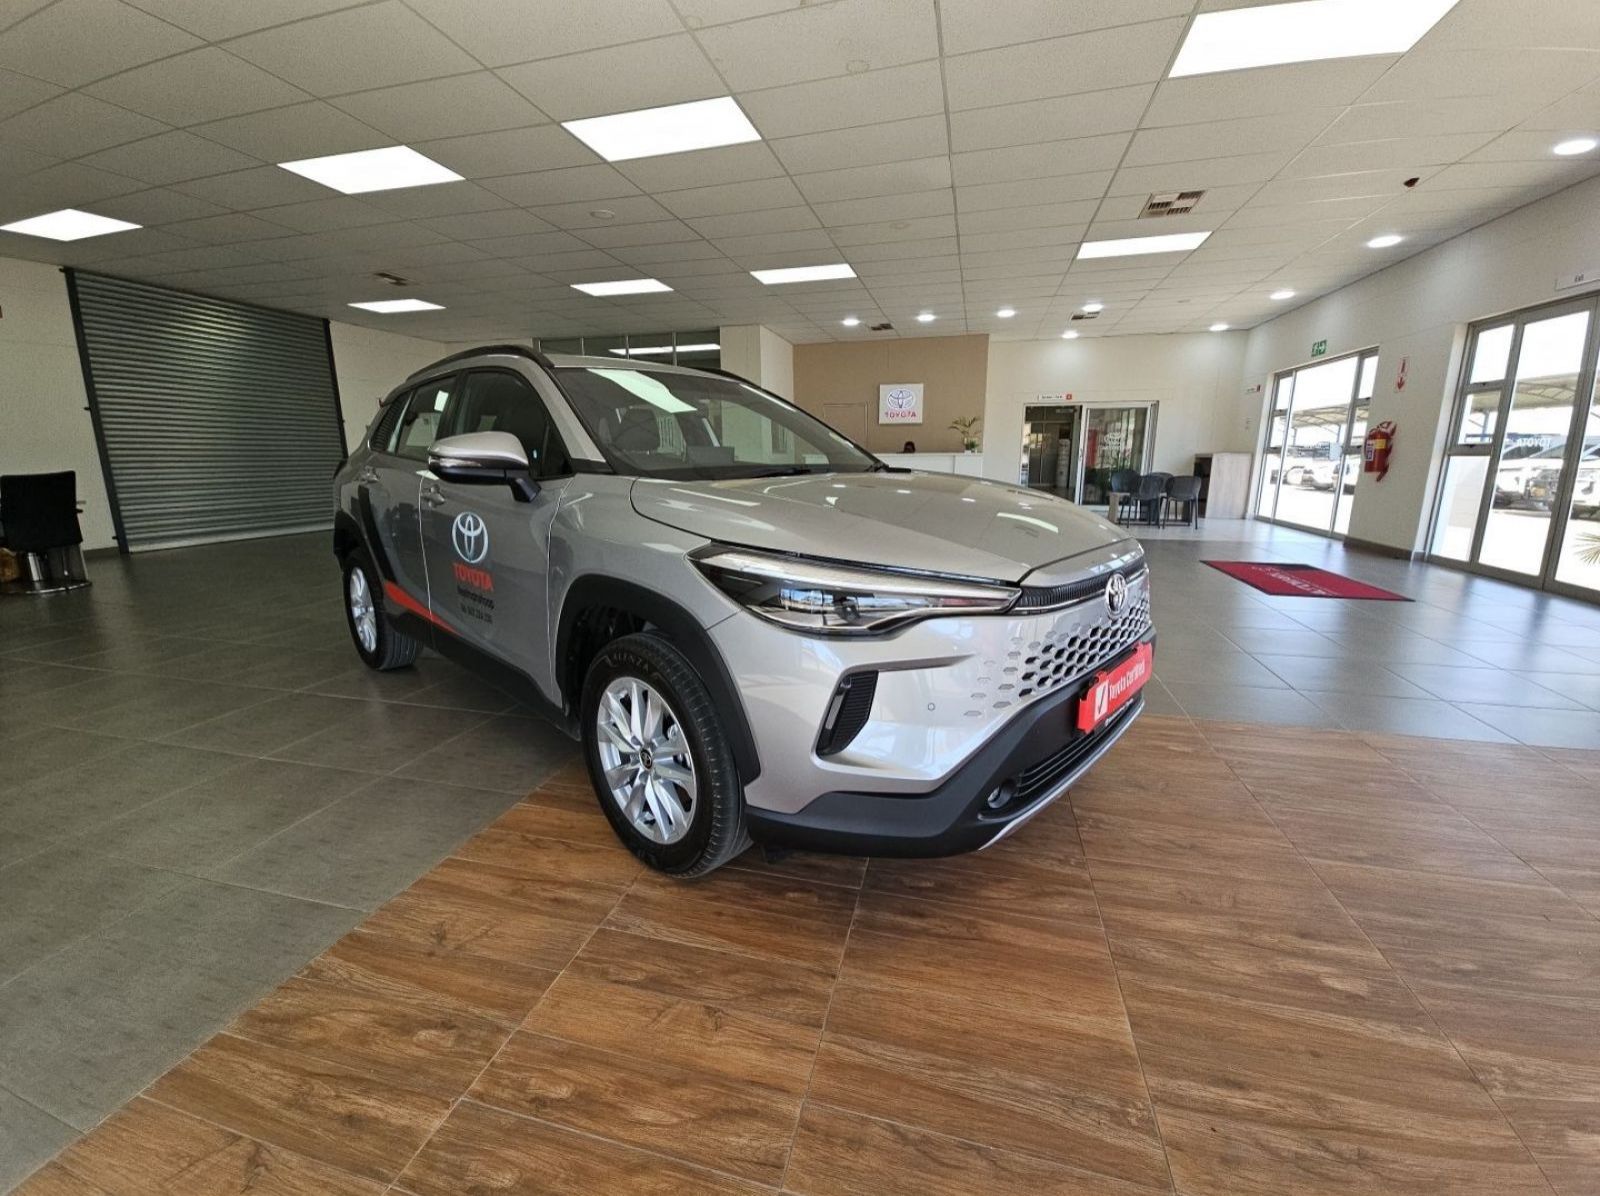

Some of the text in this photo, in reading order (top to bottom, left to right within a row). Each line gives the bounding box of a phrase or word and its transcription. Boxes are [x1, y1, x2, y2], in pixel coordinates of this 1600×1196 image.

[884, 410, 917, 419] TOYOTA
[453, 563, 494, 592] TOYOTA
[1109, 676, 1126, 701] Toyota
